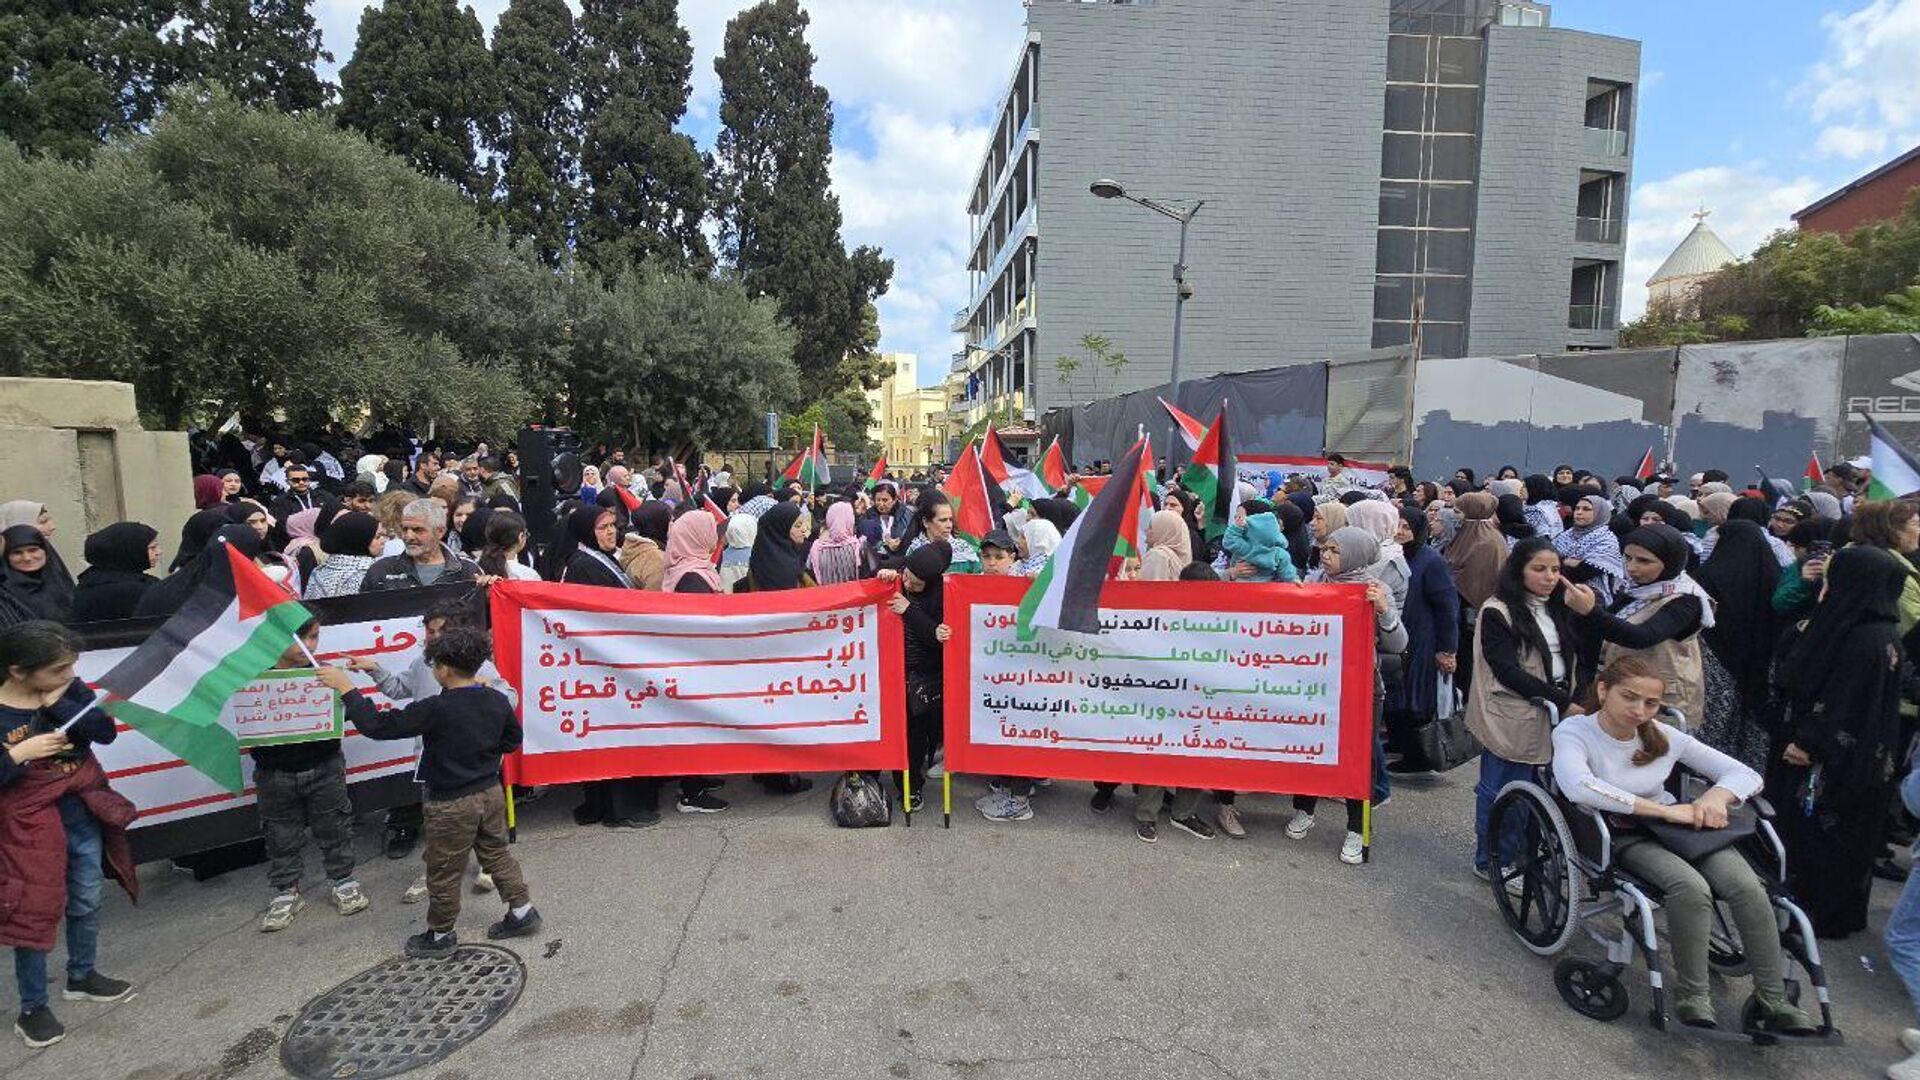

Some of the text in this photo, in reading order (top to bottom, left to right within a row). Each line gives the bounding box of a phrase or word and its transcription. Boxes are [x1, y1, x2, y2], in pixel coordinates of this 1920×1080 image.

[983, 640, 1046, 657] المجال
[1047, 642, 1073, 663] في
[312, 693, 331, 706] في
[538, 672, 867, 713] الجماعية في قطاع
[559, 702, 870, 739] غزة
